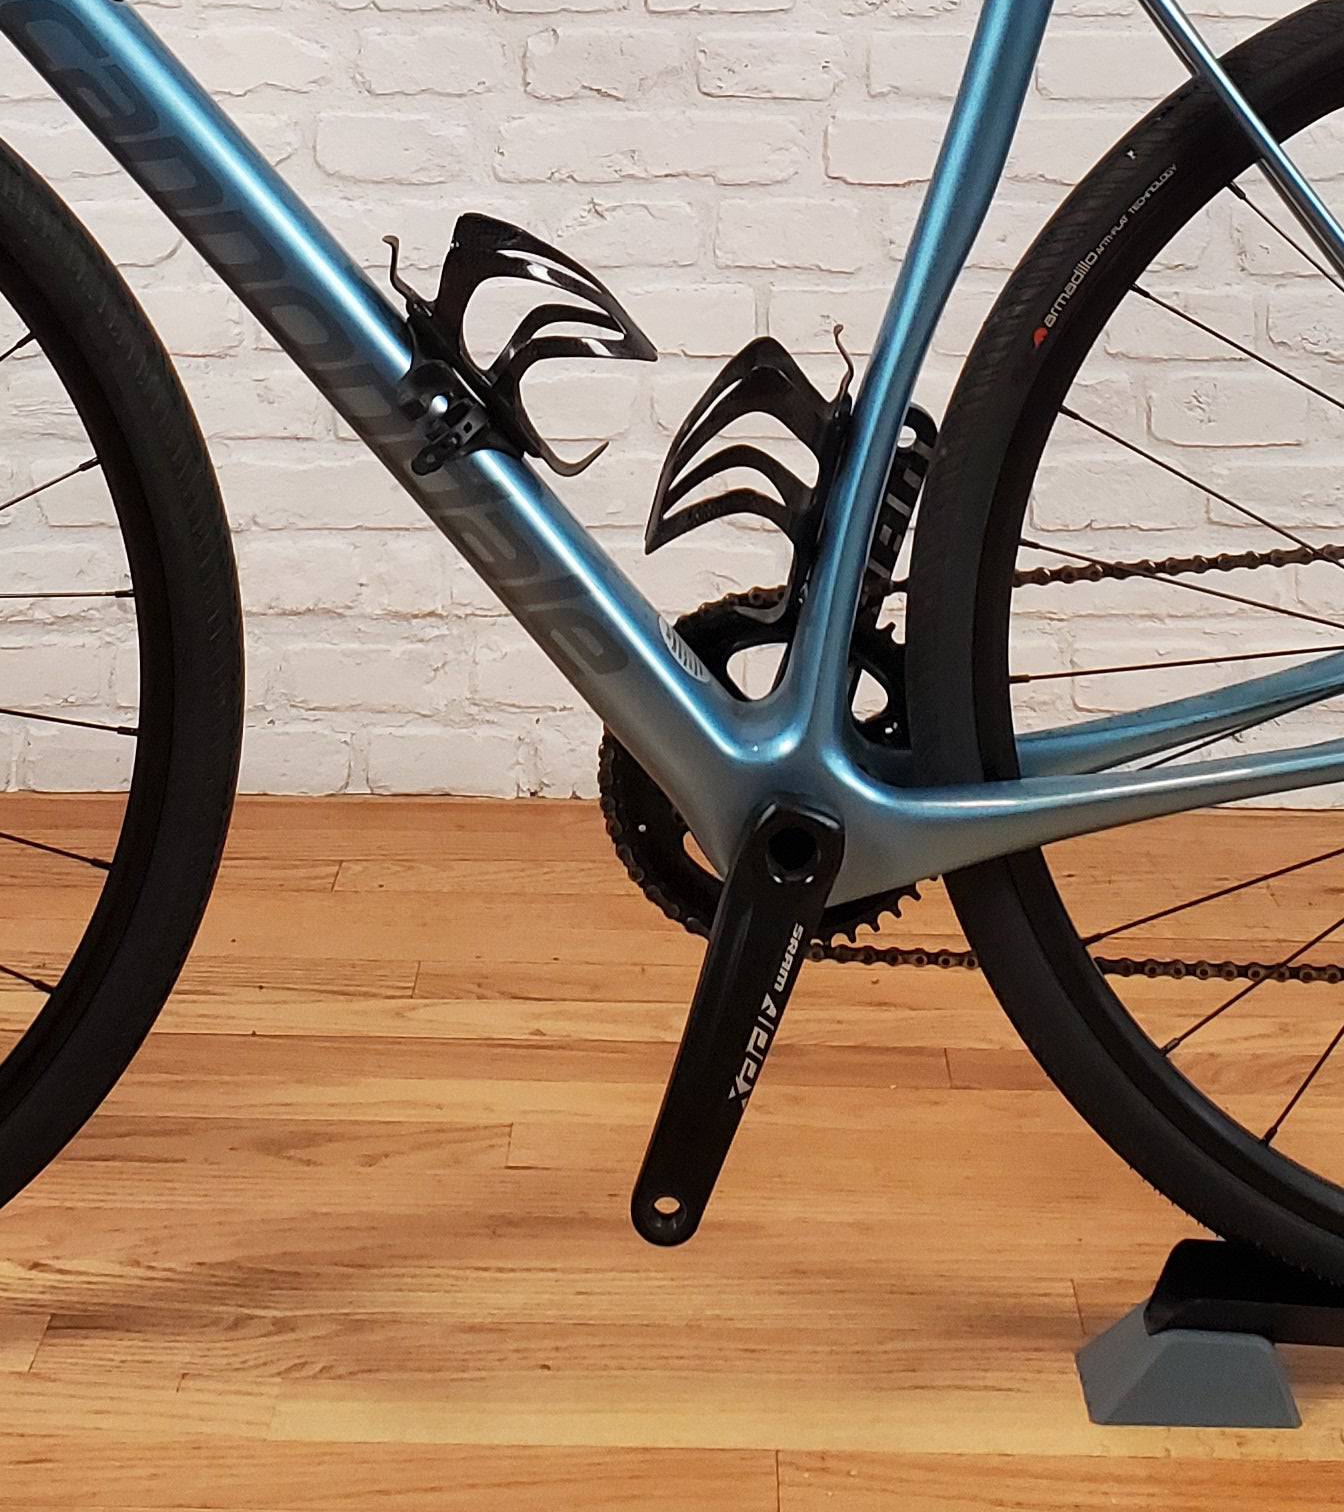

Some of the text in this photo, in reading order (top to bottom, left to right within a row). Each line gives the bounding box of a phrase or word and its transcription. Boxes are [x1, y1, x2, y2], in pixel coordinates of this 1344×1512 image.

[1043, 250, 1099, 329] armadillo
[1127, 162, 1178, 215] TECHNOLOGY
[773, 922, 806, 993] SRAM
